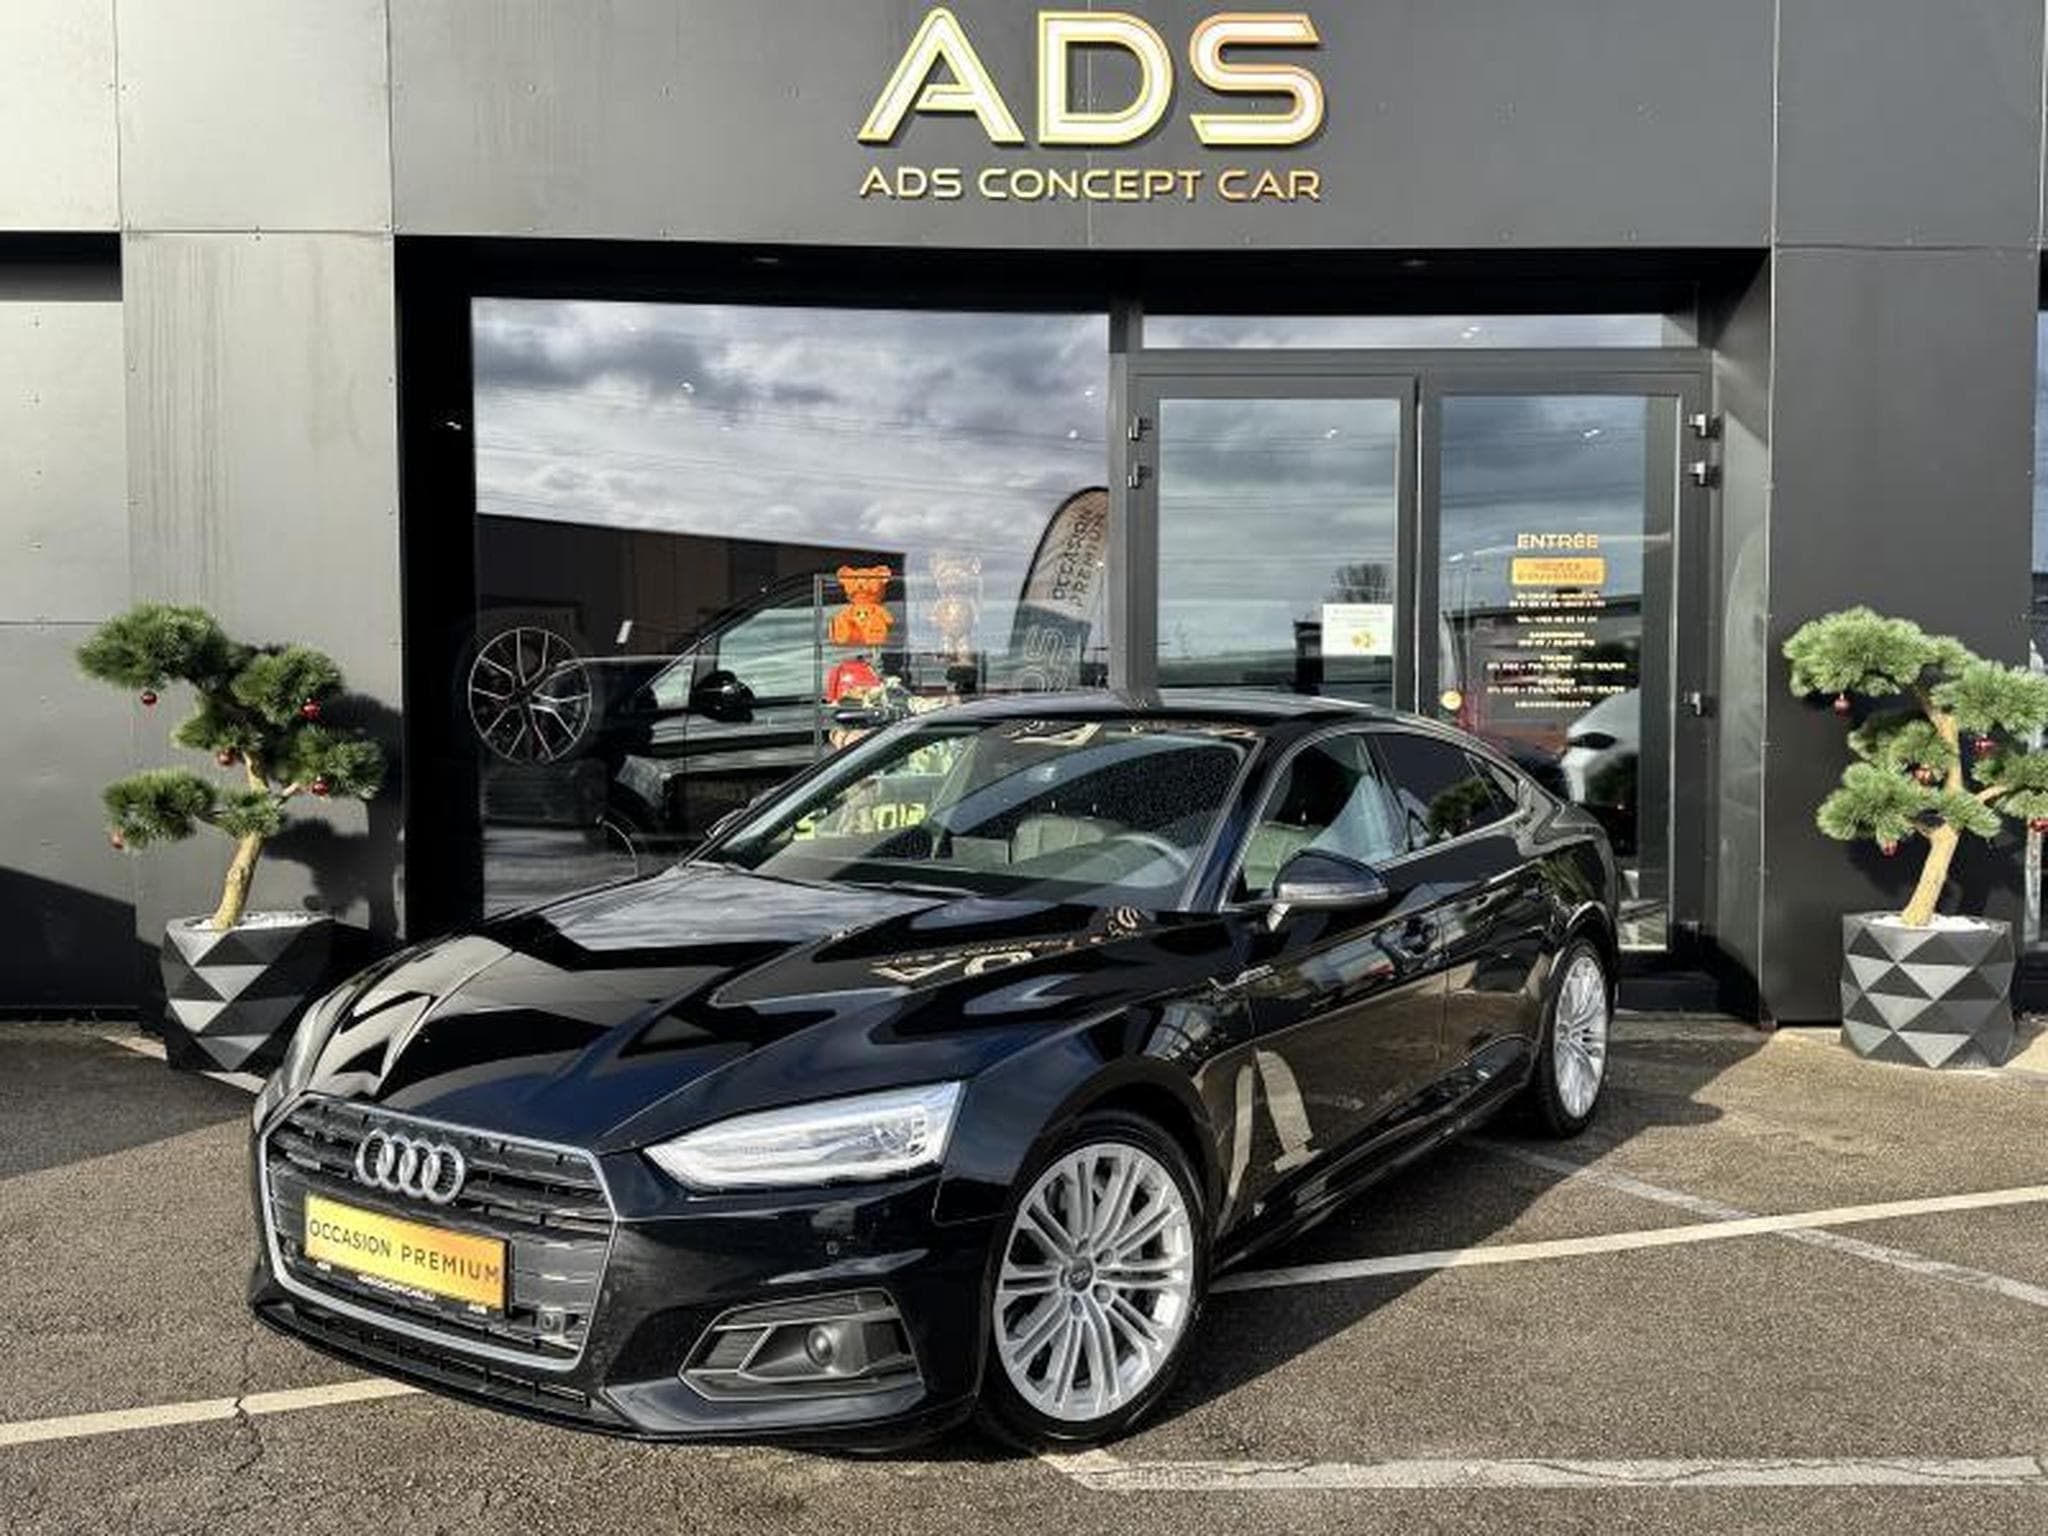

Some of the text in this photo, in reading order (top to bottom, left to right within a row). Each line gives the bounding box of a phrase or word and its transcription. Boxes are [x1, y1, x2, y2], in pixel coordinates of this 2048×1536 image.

[857, 7, 1325, 145] ADS
[859, 166, 1322, 201] ADS CONCEPT CAR
[1516, 532, 1599, 549] ENTRÉE
[308, 1219, 500, 1282] OCCASION PREMIUM
